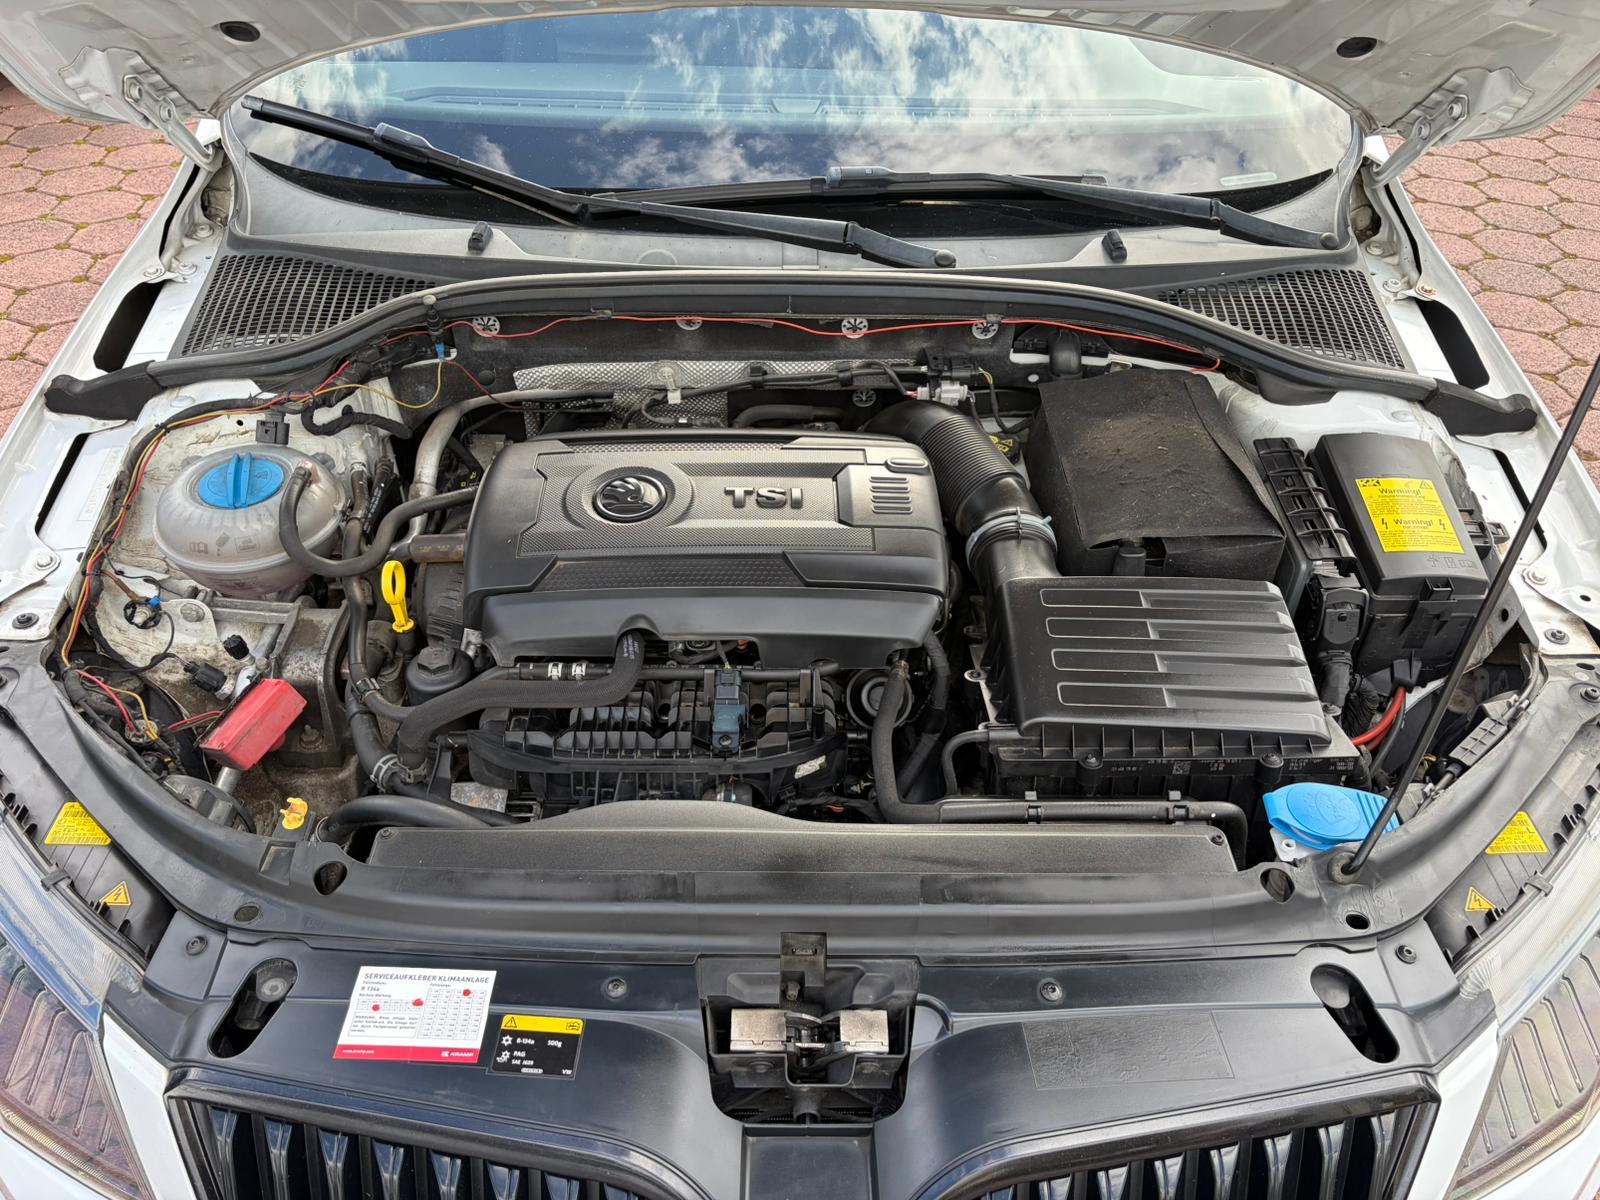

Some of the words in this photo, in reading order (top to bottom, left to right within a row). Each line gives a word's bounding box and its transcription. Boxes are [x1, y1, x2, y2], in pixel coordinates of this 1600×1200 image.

[724, 487, 803, 509] TSI
[1393, 518, 1434, 527] Warning!
[364, 973, 437, 982] SERVICEAUFKLEBER
[437, 975, 490, 984] KLIMAANLAGE
[547, 1040, 563, 1048] 500g
